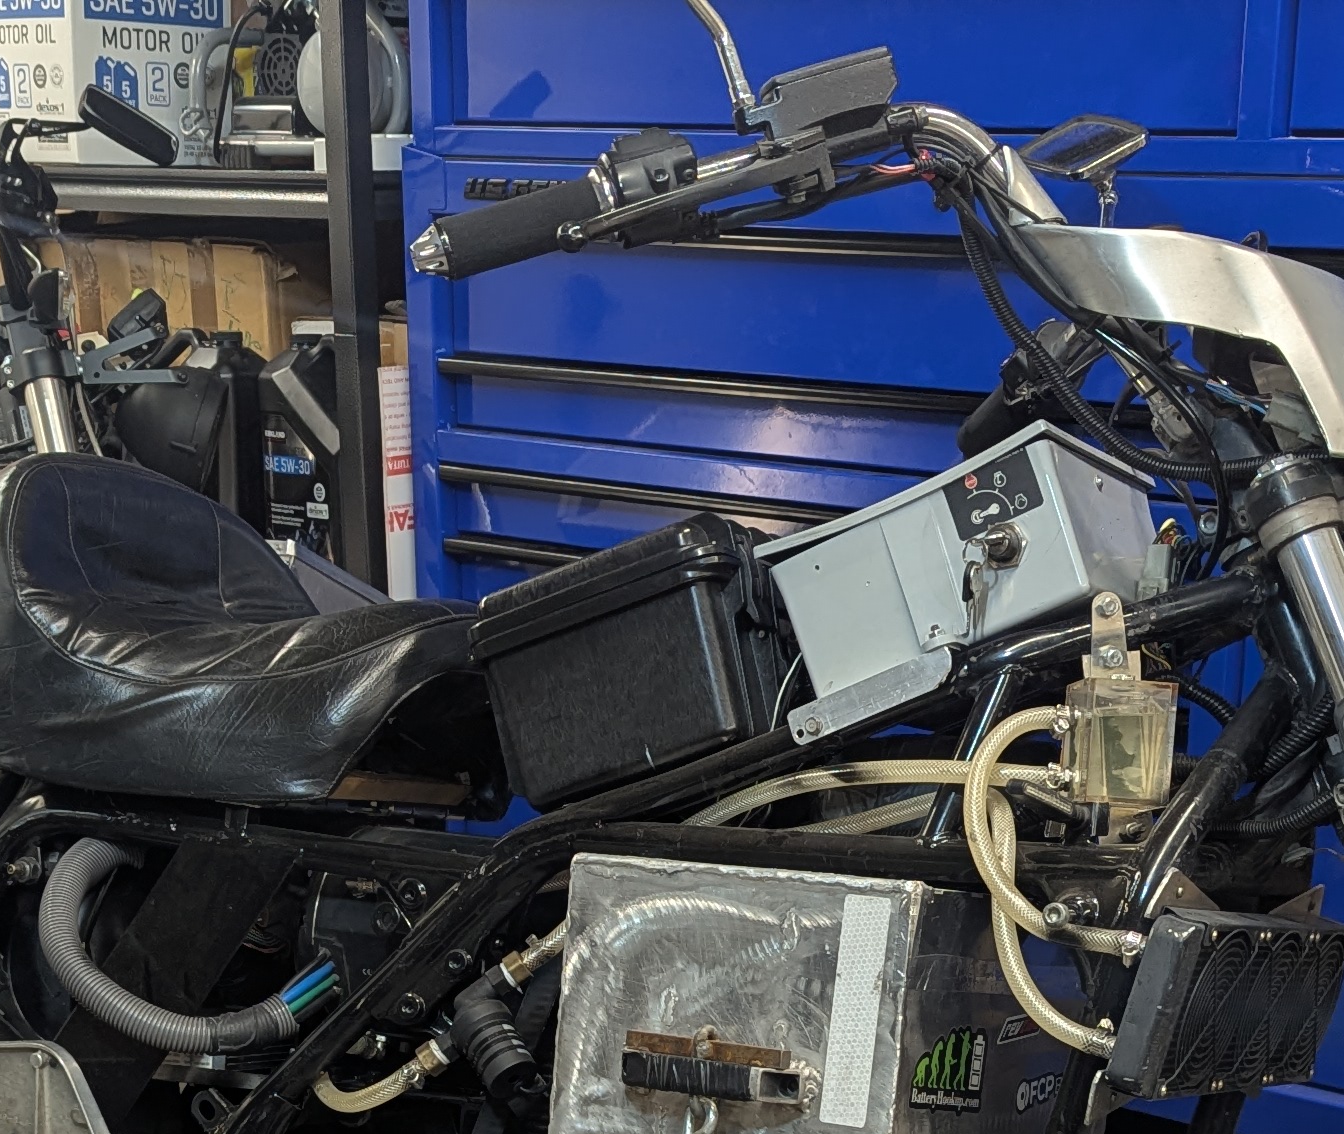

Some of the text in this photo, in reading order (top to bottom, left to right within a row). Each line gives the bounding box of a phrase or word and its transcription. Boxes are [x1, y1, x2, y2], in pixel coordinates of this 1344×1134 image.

[89, 0, 218, 21] SAE 5W-30
[35, 23, 56, 44] OIL
[102, 25, 205, 54] MOTOR OI
[17, 68, 27, 94] 2
[121, 80, 131, 98] 5
[151, 66, 165, 92] 2
[150, 94, 167, 103] PACK
[281, 456, 311, 475] 5W-30
